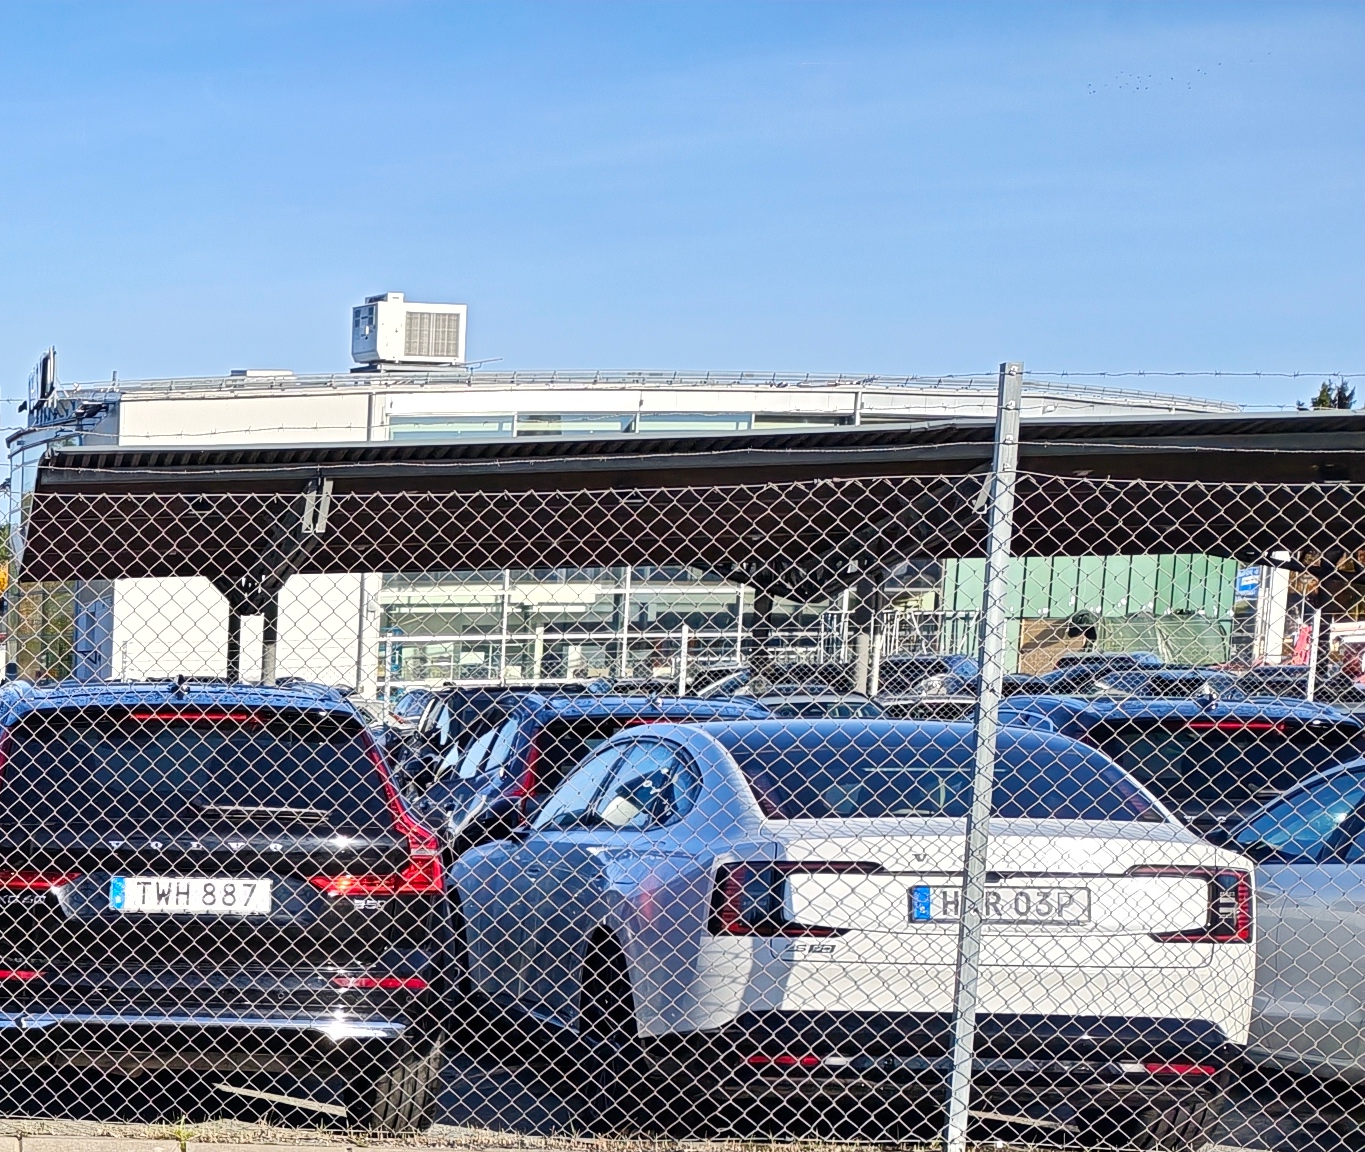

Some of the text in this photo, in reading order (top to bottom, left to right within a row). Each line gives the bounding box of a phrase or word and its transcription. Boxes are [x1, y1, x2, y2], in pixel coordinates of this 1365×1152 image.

[108, 841, 283, 852] VOLVO
[136, 881, 257, 907] TWH 887
[942, 890, 1003, 916] HR
